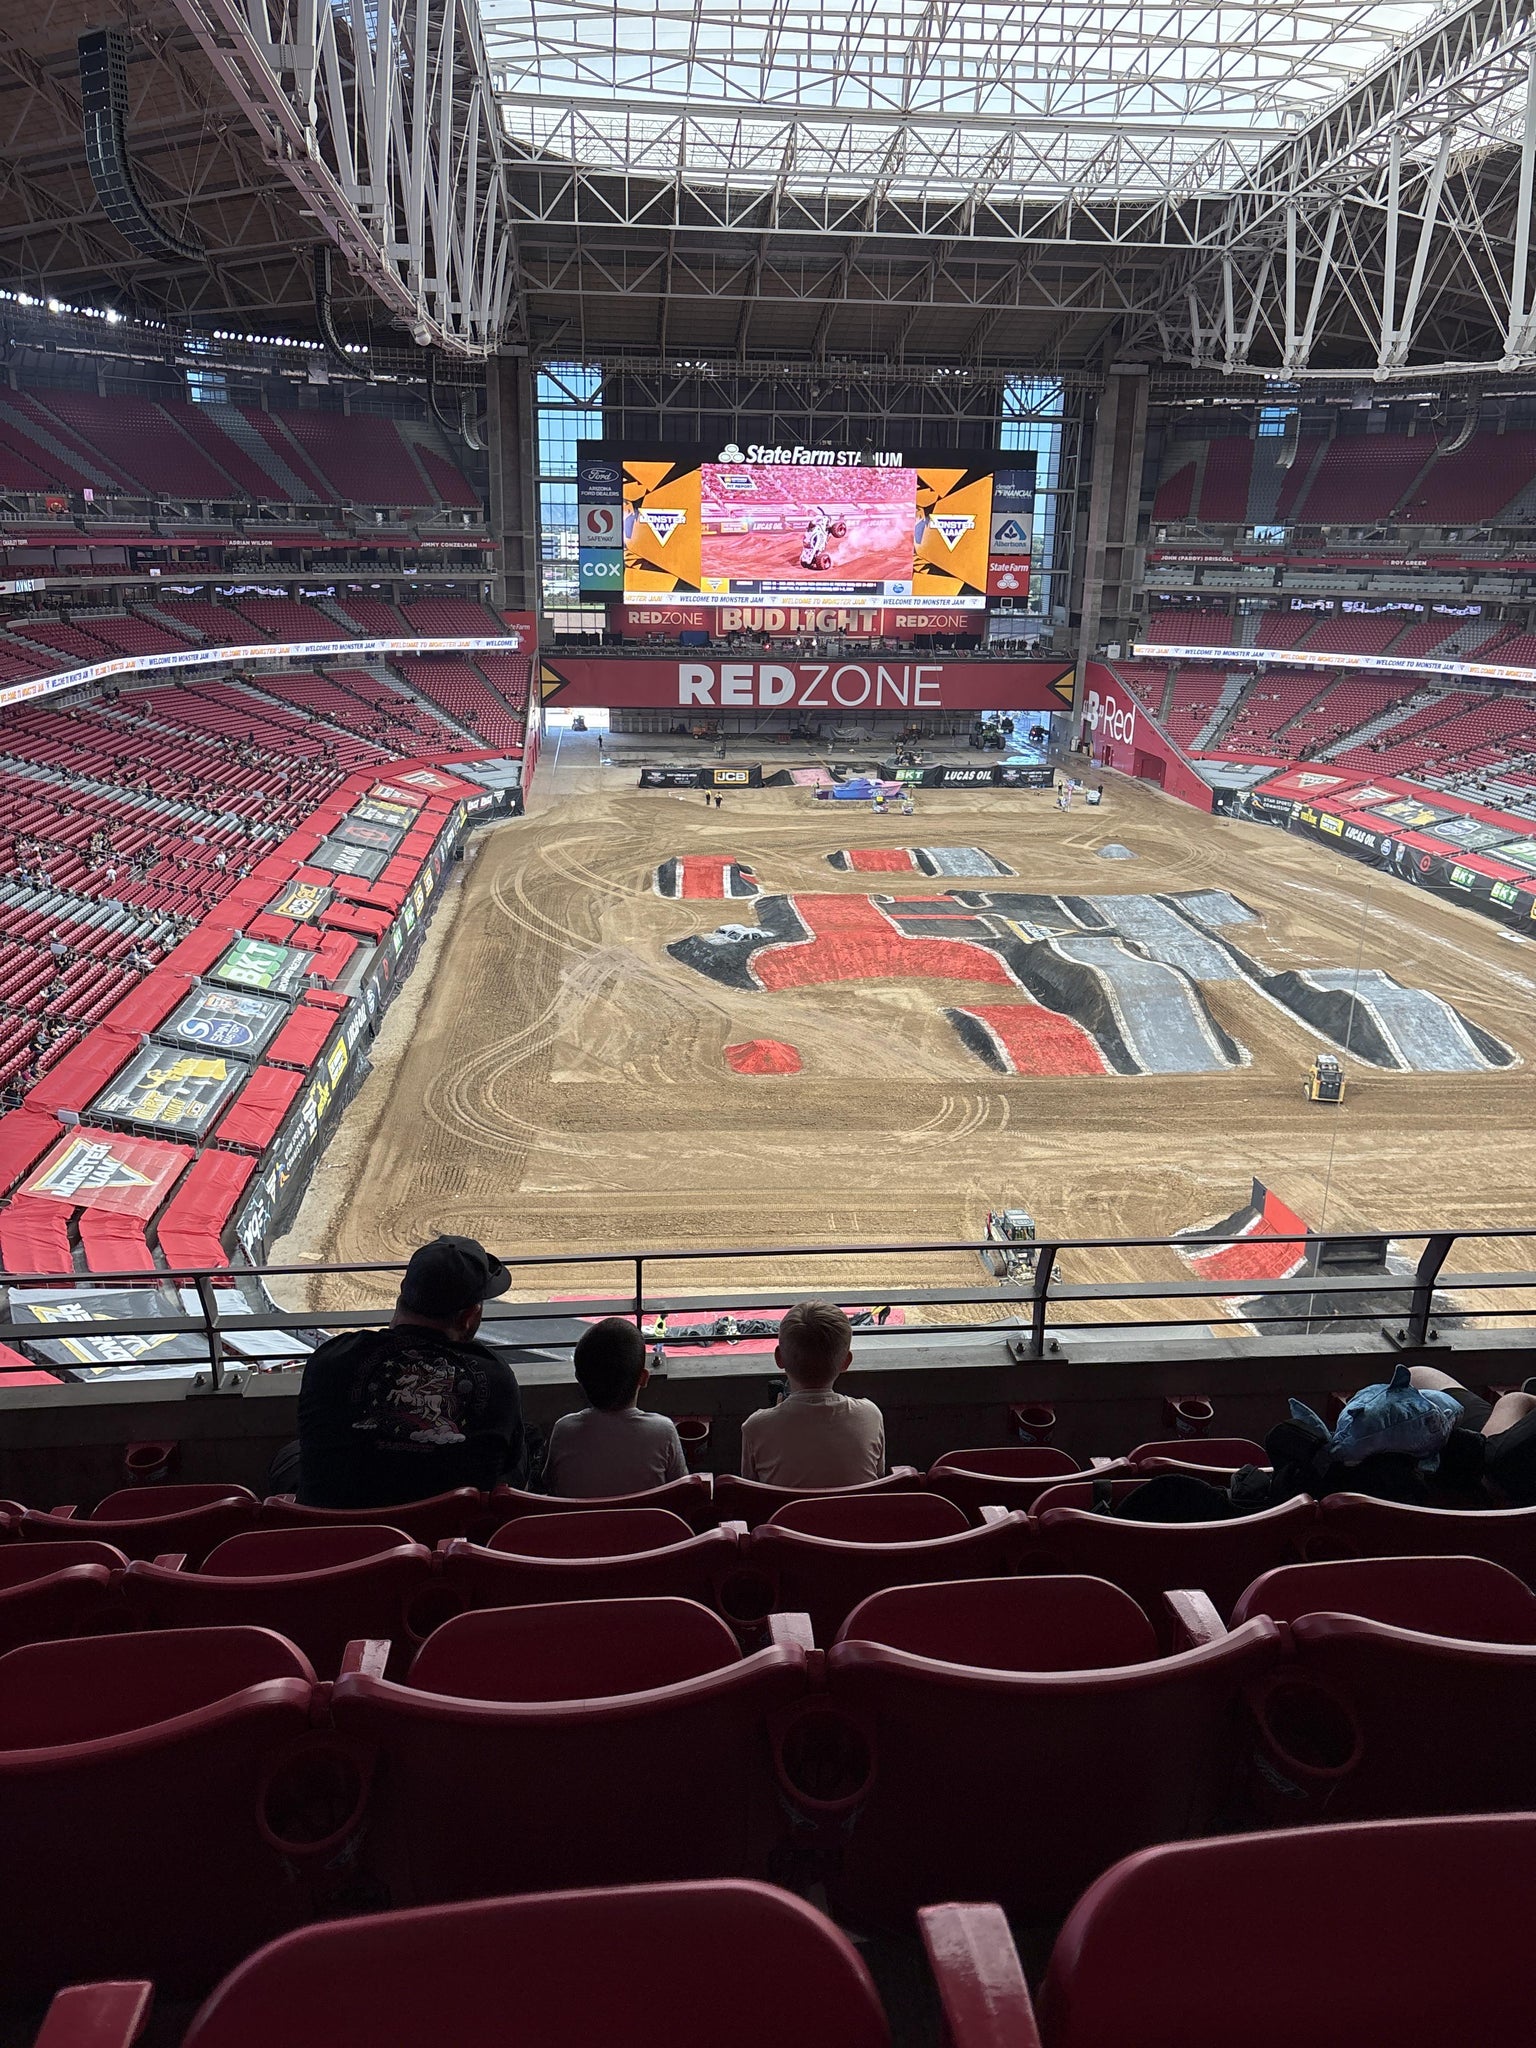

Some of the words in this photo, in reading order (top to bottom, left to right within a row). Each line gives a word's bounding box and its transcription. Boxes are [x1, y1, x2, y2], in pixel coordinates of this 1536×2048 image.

[837, 452, 902, 467] STAIUM
[639, 515, 686, 524] MONSTER
[753, 522, 772, 530] LUCAS
[929, 521, 976, 529] MONSTER
[652, 523, 673, 531] JAM
[943, 528, 962, 536] JAM
[993, 540, 1027, 548] Albertsons
[583, 562, 621, 577] COX
[628, 611, 703, 625] REDZONE
[722, 607, 785, 631] BUD
[790, 608, 877, 632] LIGHT
[896, 615, 968, 628] REDZONE
[305, 644, 331, 652] WELCOME
[1376, 659, 1405, 667] WELCOME
[1415, 661, 1442, 669] MONSTER
[678, 664, 942, 706] REDZONE
[716, 772, 747, 782] JCB
[896, 769, 924, 781] BKT
[944, 771, 975, 781] LUCAS
[976, 770, 993, 781] OIL
[1345, 826, 1365, 845] LUCAS
[1364, 834, 1375, 848] OIL
[1452, 867, 1476, 886] BKT
[1491, 884, 1518, 904] BKT
[226, 941, 279, 984] BKT
[51, 1142, 113, 1198] MONSTER
[88, 1160, 122, 1187] JAM
